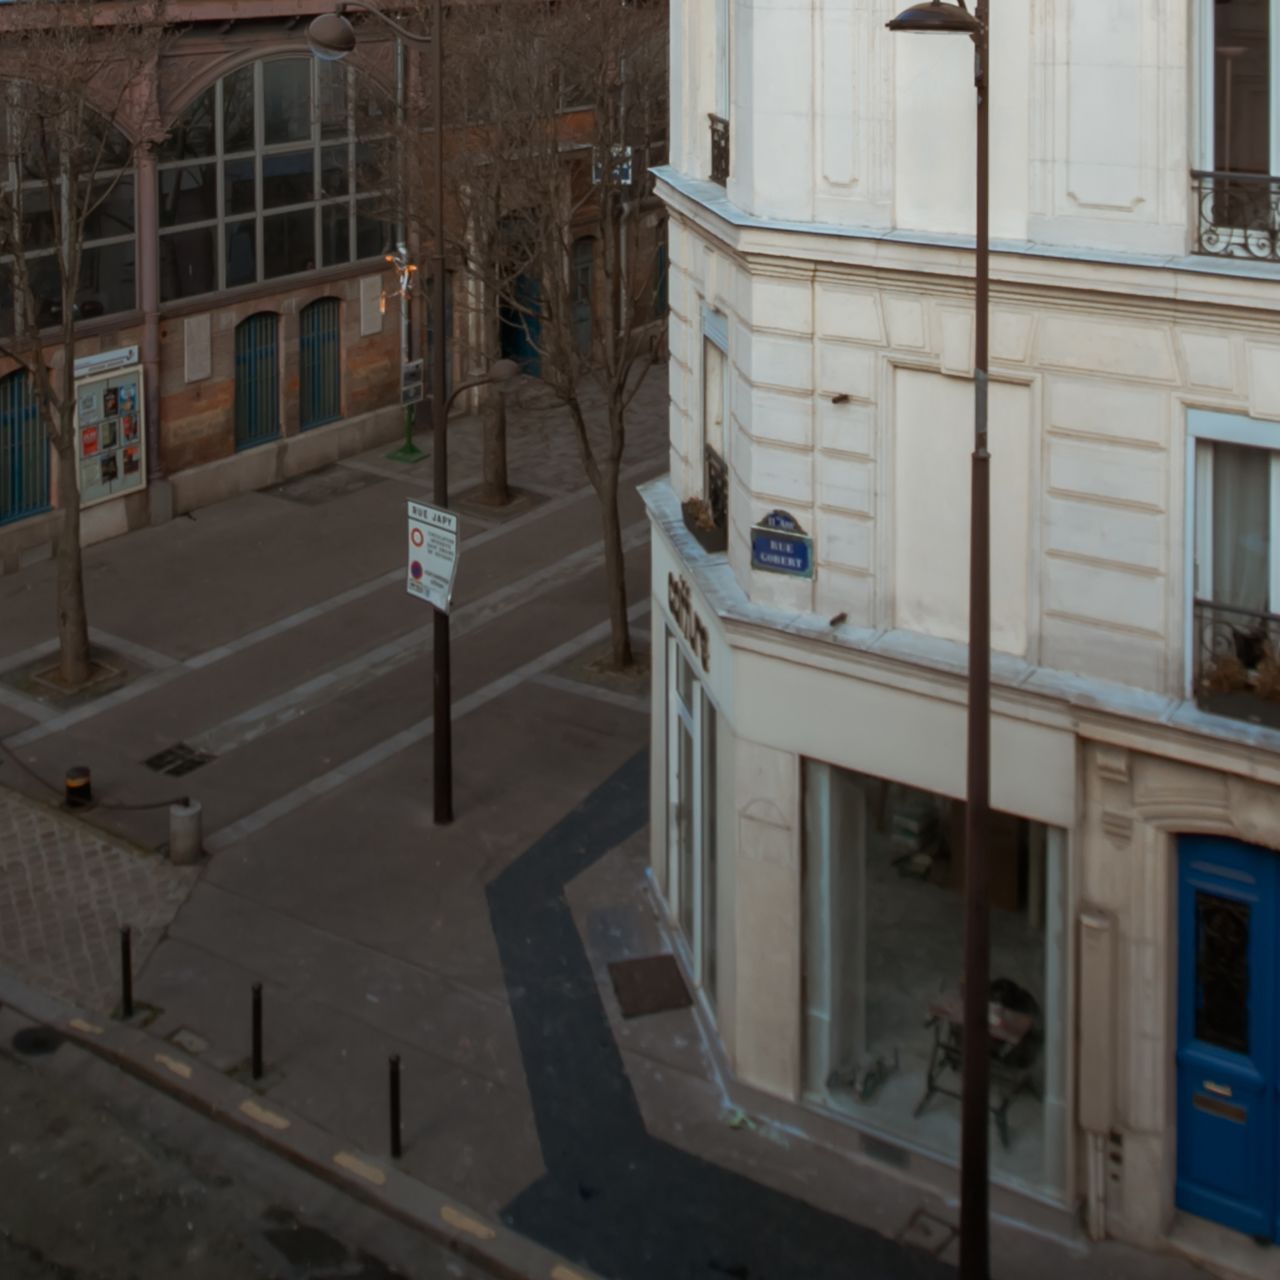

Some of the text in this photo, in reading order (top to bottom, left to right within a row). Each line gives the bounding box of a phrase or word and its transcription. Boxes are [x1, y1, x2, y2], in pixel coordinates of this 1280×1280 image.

[412, 506, 452, 527] RUE JAPY
[770, 540, 794, 554] RUE
[760, 552, 802, 568] GOBERT
